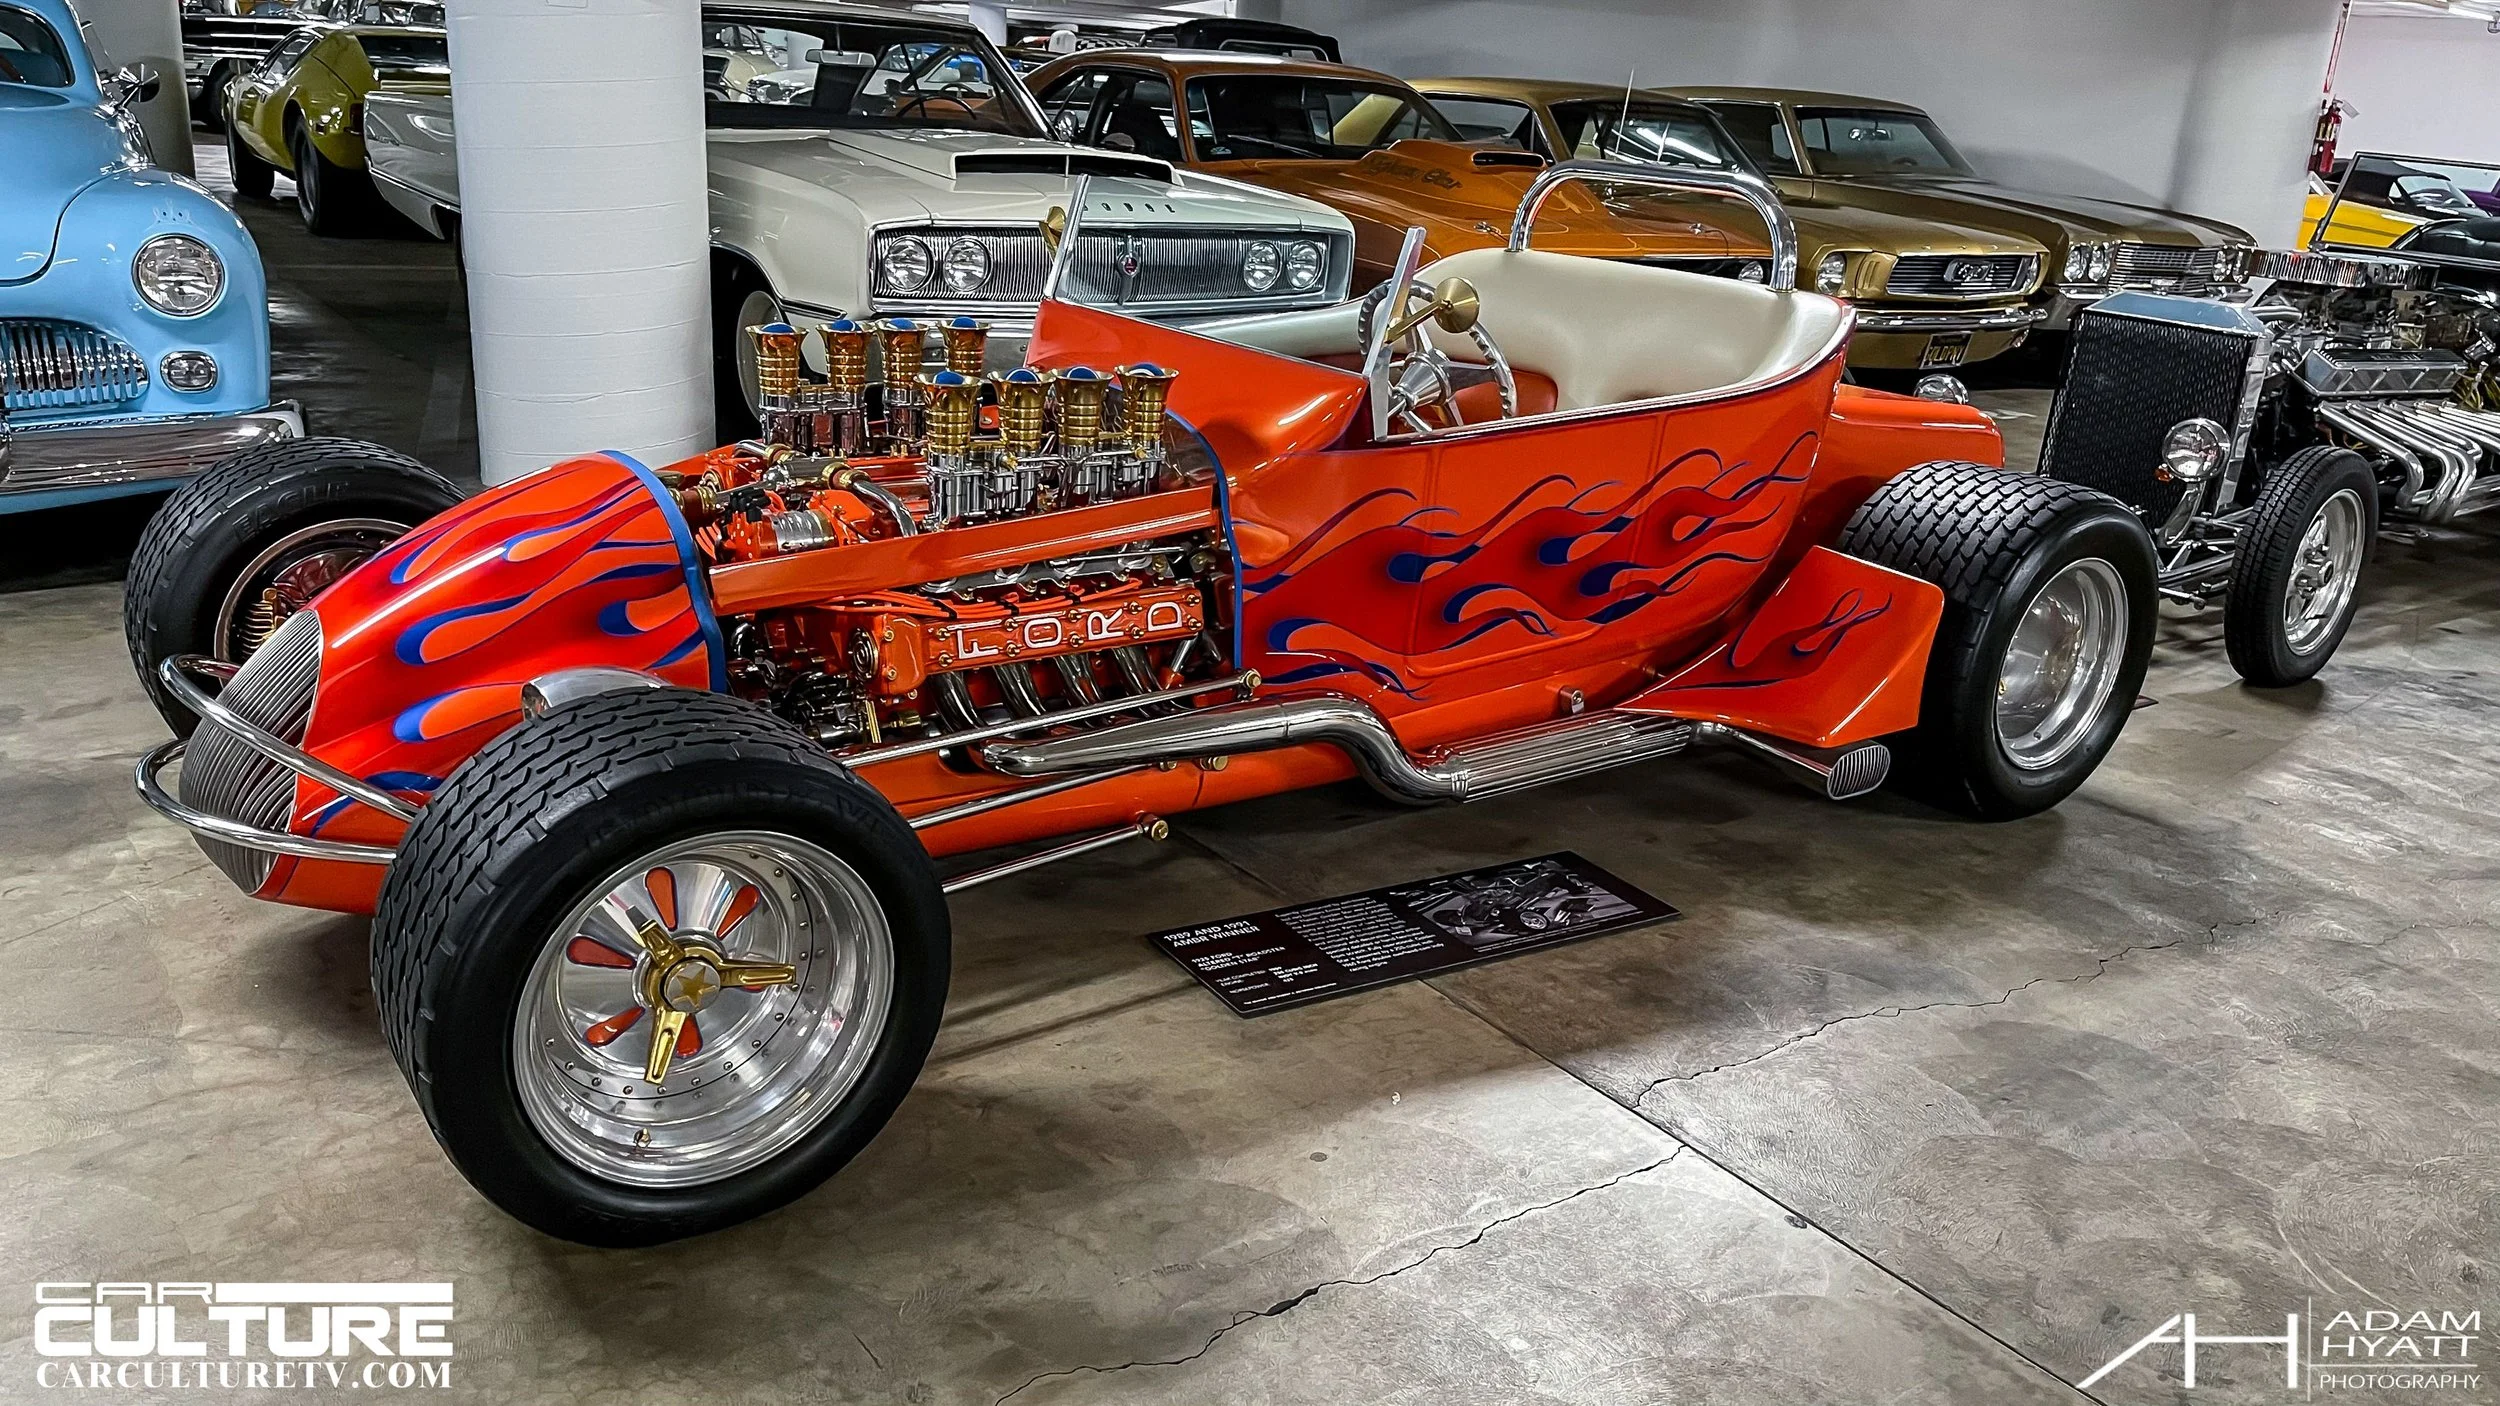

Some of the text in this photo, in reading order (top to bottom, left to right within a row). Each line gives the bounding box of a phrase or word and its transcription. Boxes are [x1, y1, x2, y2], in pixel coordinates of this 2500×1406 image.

[957, 601, 1183, 659] FORD
[1164, 921, 1250, 941] 1989 AND 1991
[1174, 926, 1260, 947] AMBR WINNER
